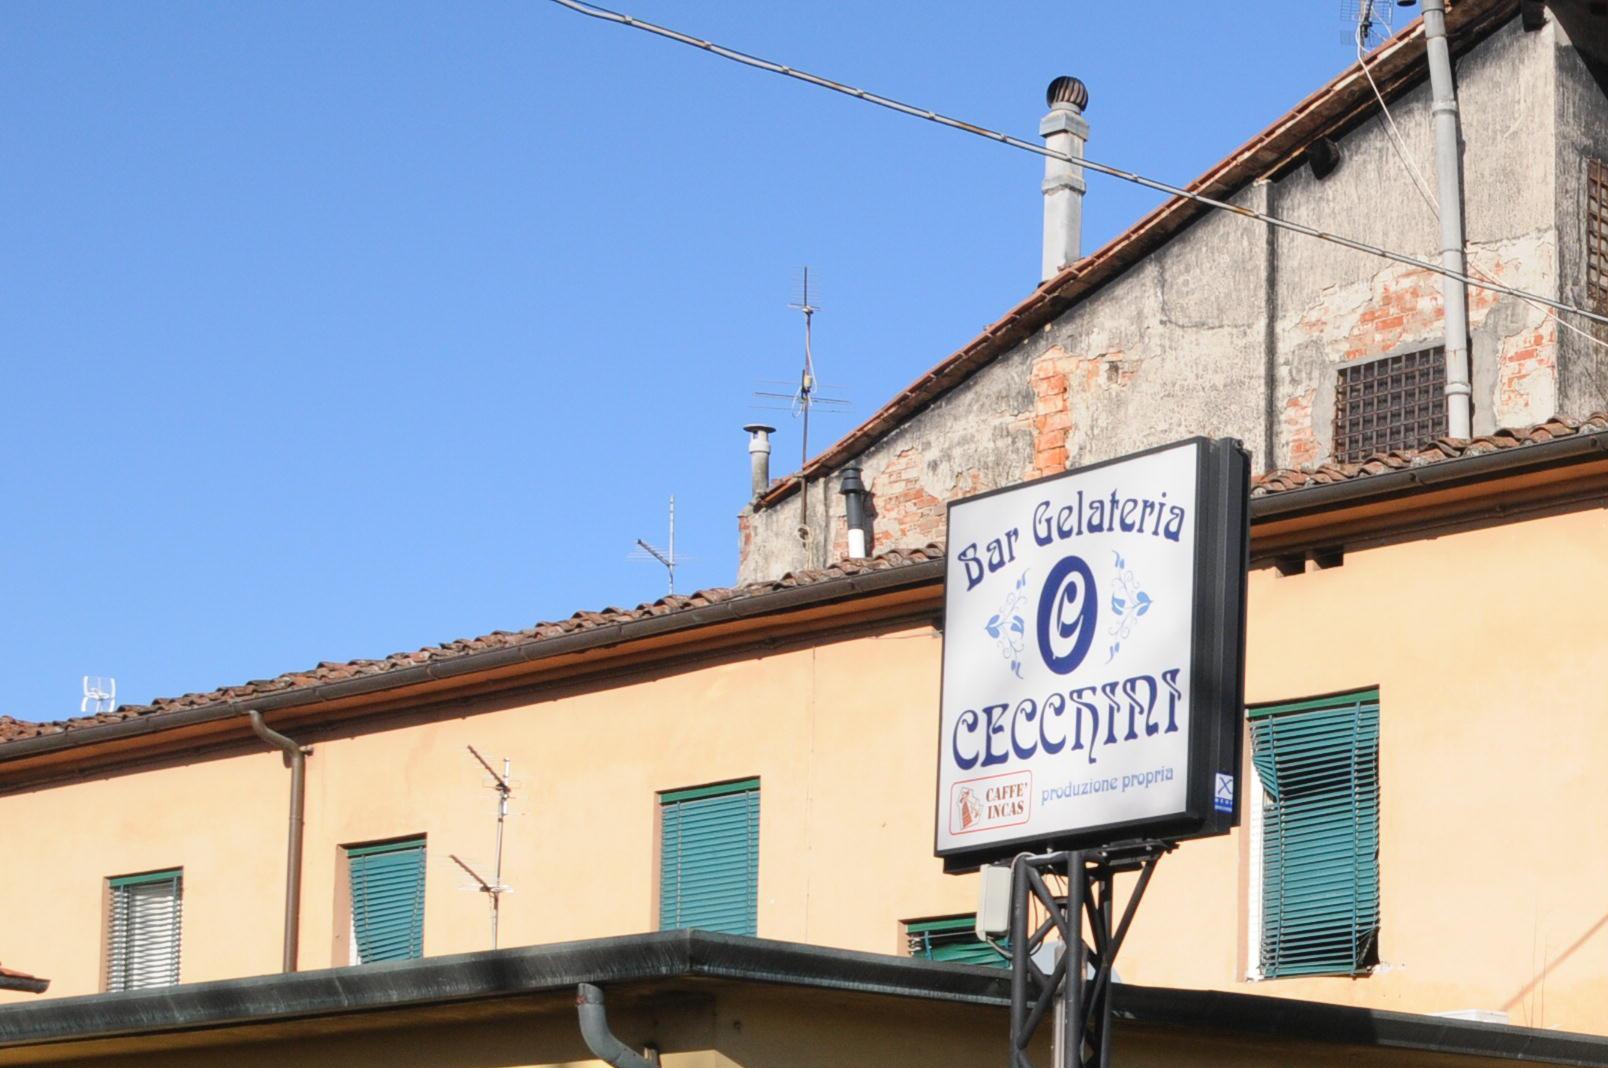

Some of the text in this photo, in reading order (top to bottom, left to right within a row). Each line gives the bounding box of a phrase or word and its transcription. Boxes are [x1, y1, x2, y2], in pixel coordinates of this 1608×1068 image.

[957, 487, 1187, 592] Bar Gelateria
[951, 667, 1181, 772] CECCHINI
[987, 801, 1024, 821] INCAS
[1041, 767, 1174, 803] produzione propria
